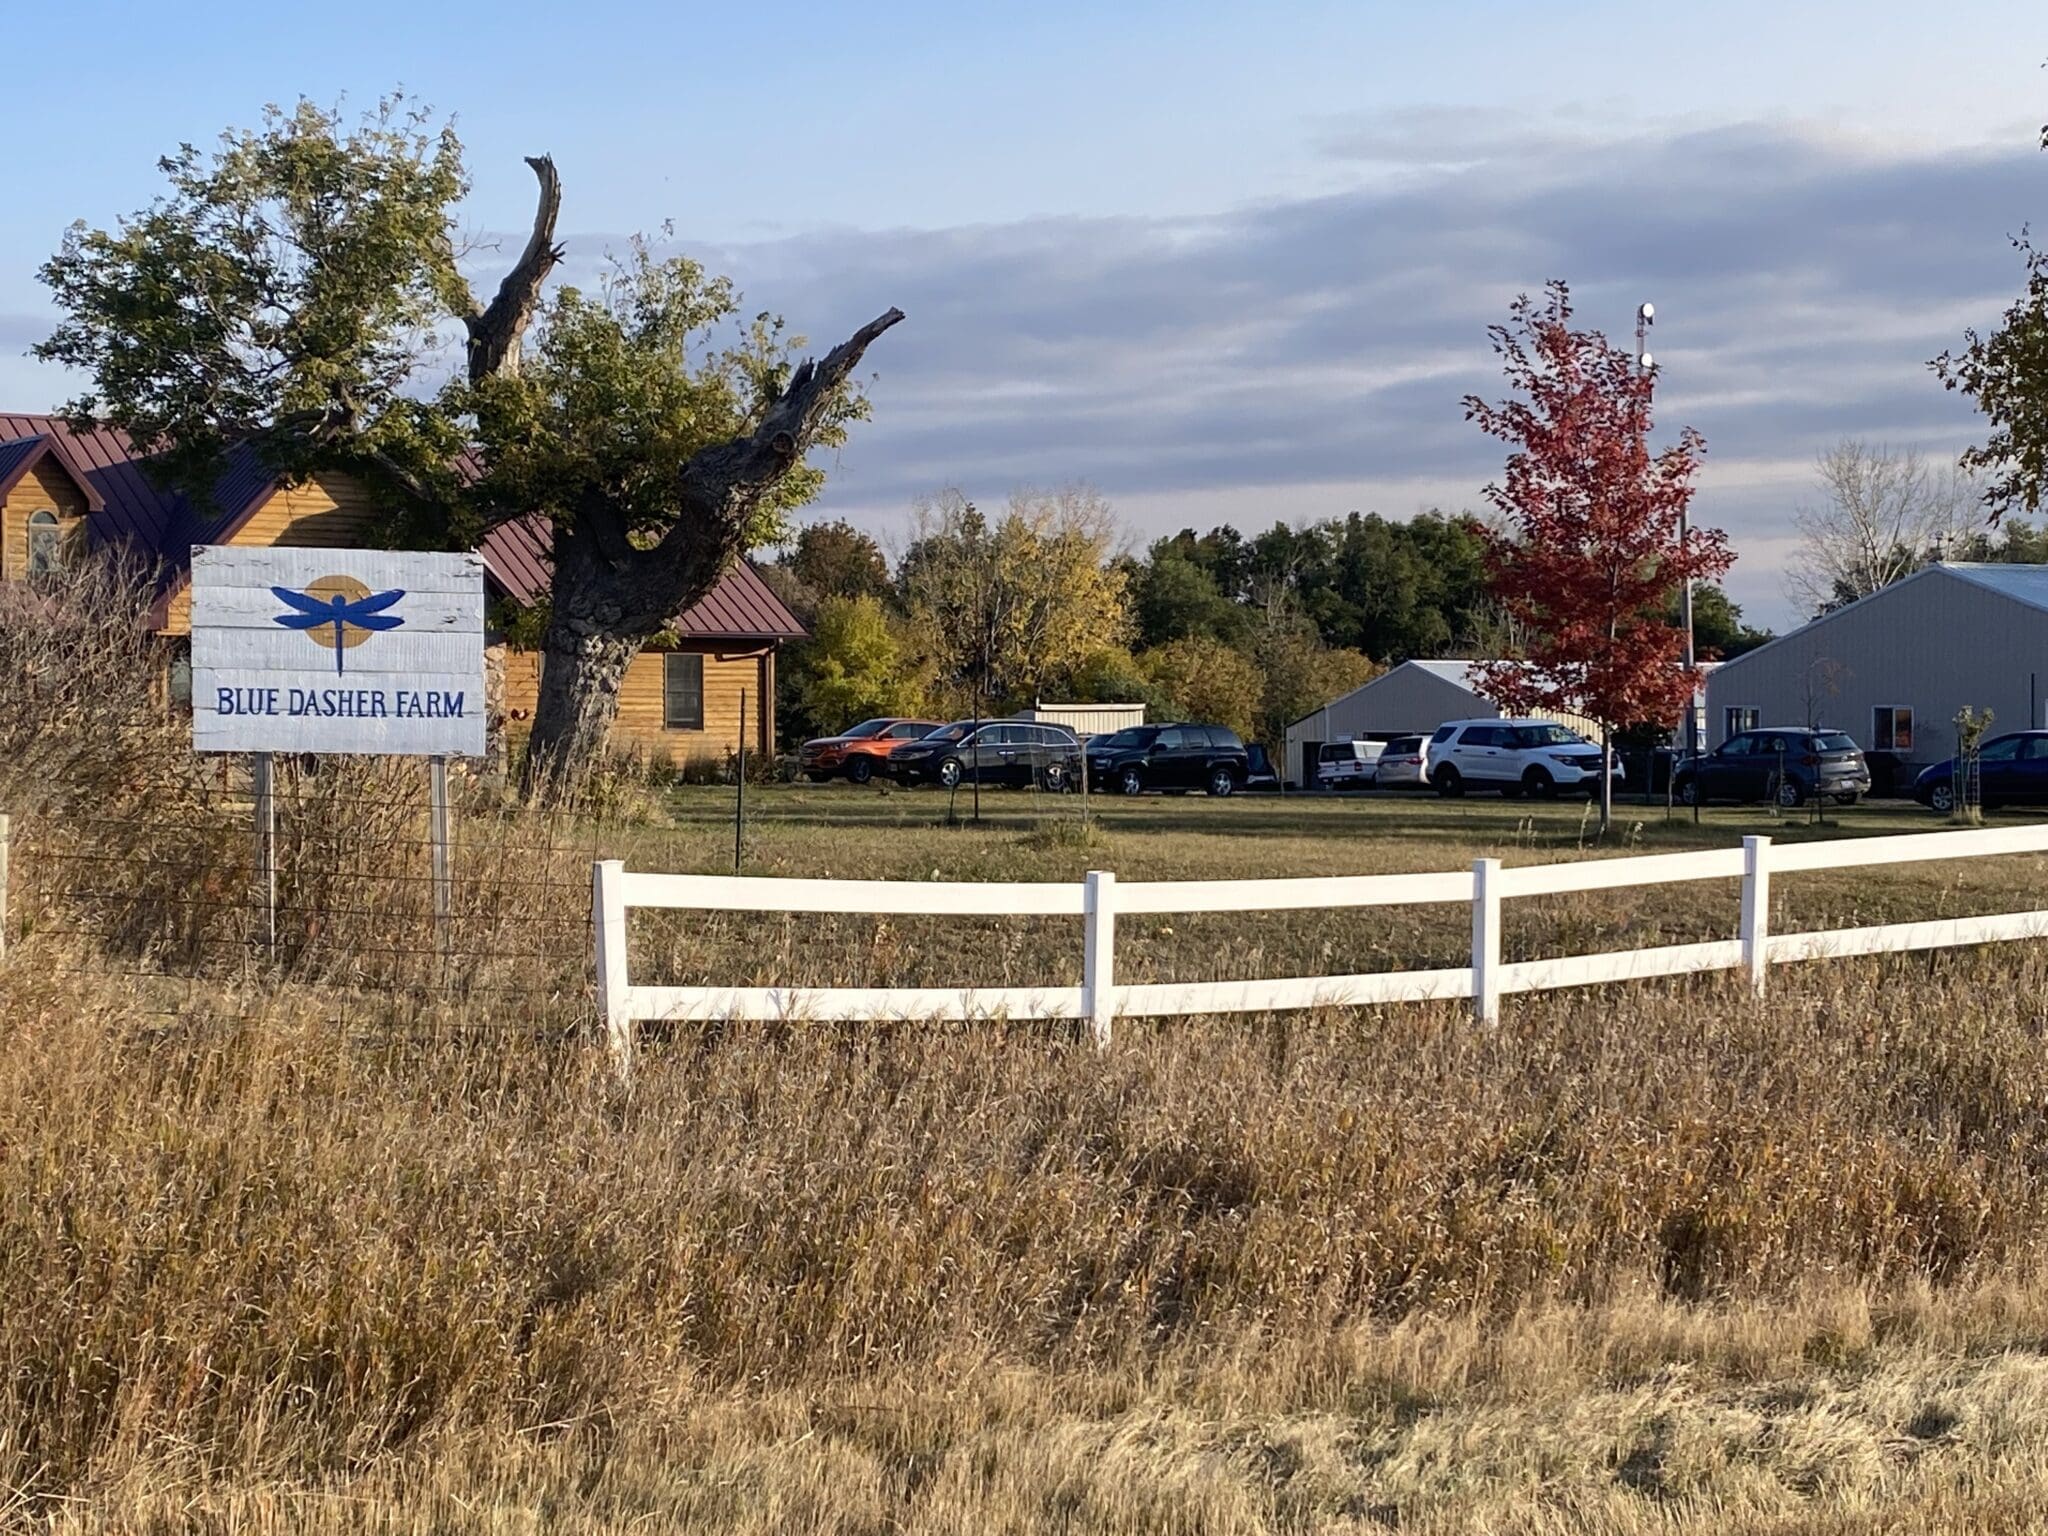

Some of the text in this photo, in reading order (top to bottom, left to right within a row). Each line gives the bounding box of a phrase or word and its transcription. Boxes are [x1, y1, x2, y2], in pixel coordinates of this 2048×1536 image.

[217, 687, 464, 718] BLUE DASHER FARM
